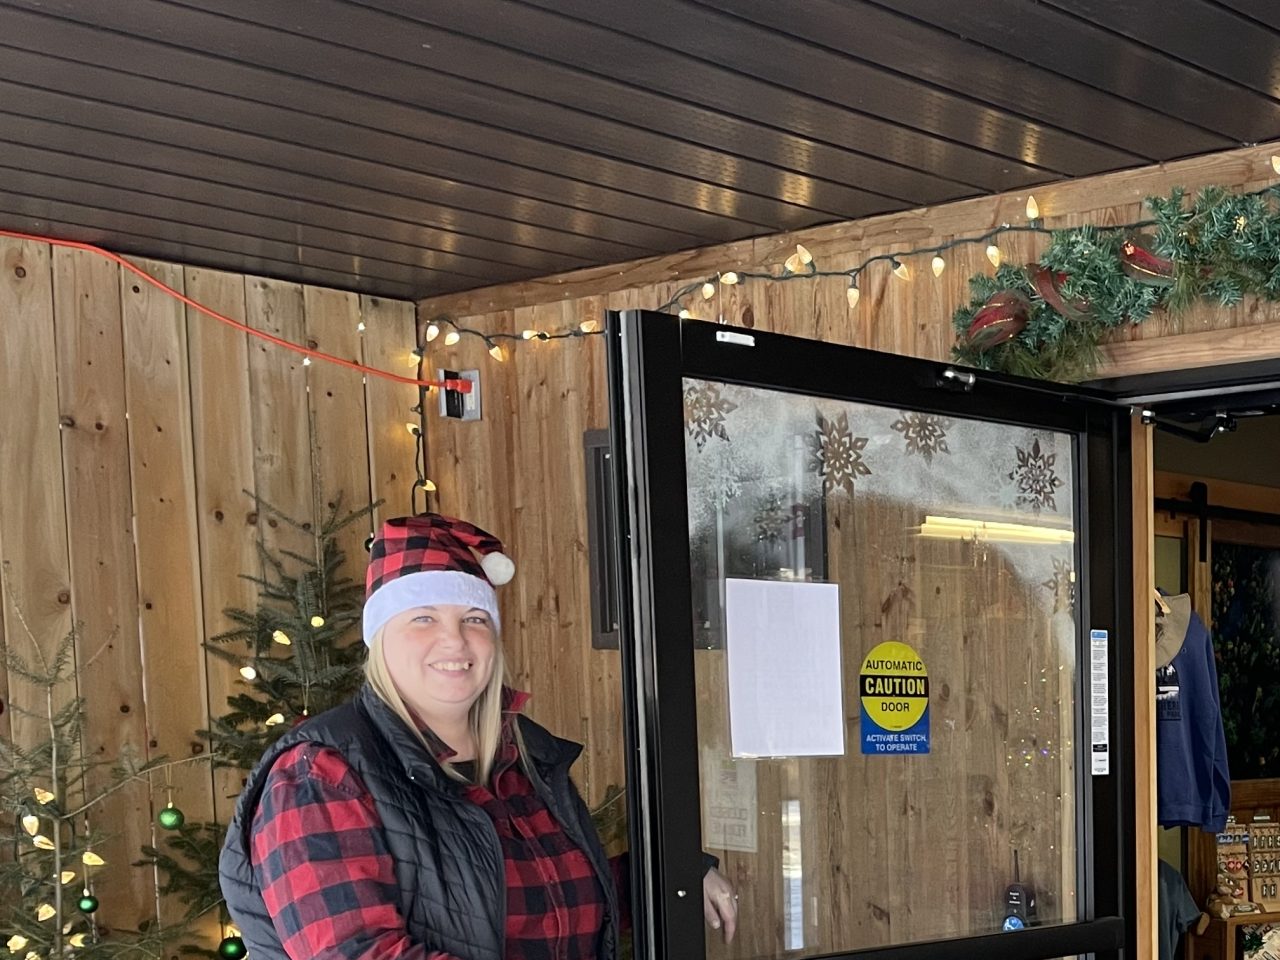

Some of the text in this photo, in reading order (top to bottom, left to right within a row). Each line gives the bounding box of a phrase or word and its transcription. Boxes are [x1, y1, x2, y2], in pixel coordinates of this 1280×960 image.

[866, 660, 922, 671] AUTOMATIC
[865, 677, 925, 695] CAUTION
[881, 702, 910, 712] DOOR
[866, 734, 926, 742] ACTIVATE SWITCH
